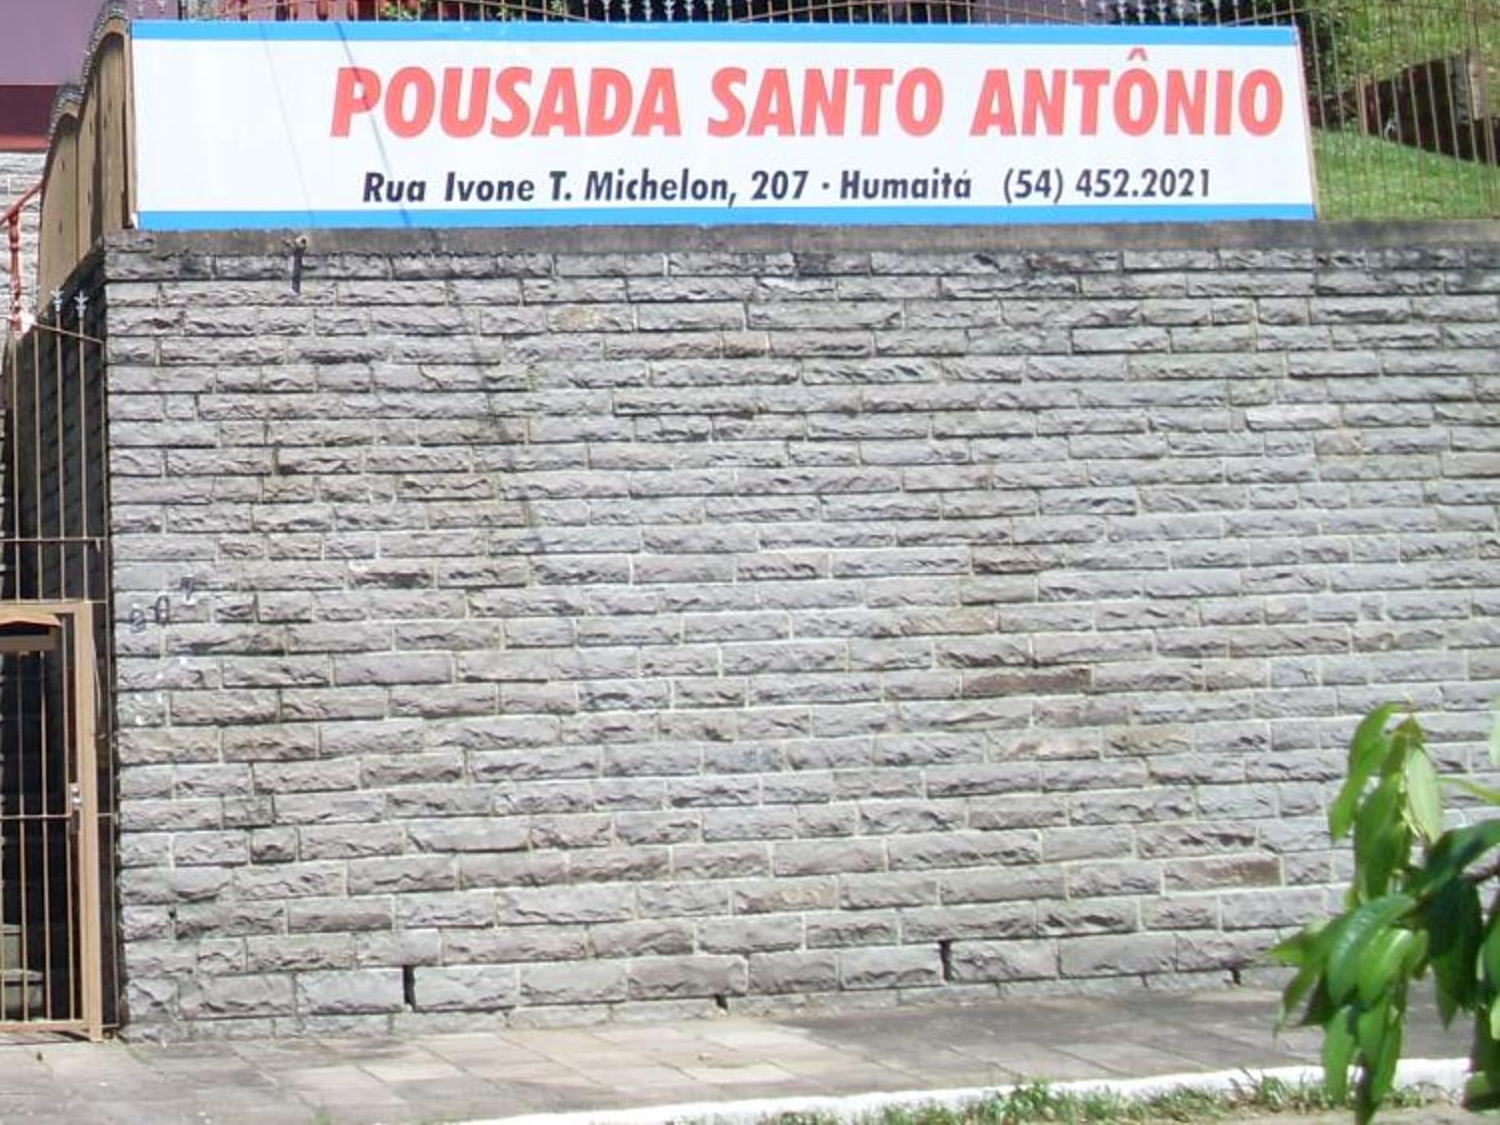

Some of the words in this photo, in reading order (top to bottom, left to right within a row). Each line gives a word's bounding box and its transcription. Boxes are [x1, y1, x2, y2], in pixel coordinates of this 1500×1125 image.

[331, 66, 682, 138] POUSADA
[707, 67, 944, 137] SANTO
[970, 48, 1283, 136] ANTÔNIO
[362, 172, 426, 202] Rua
[444, 171, 535, 202] Ivone
[549, 170, 573, 201] T.
[584, 168, 737, 207] Michelon,
[750, 170, 809, 200] 207
[840, 167, 972, 199] Humaitá
[1003, 168, 1064, 204] (54)
[1075, 168, 1210, 198] 452.2021
